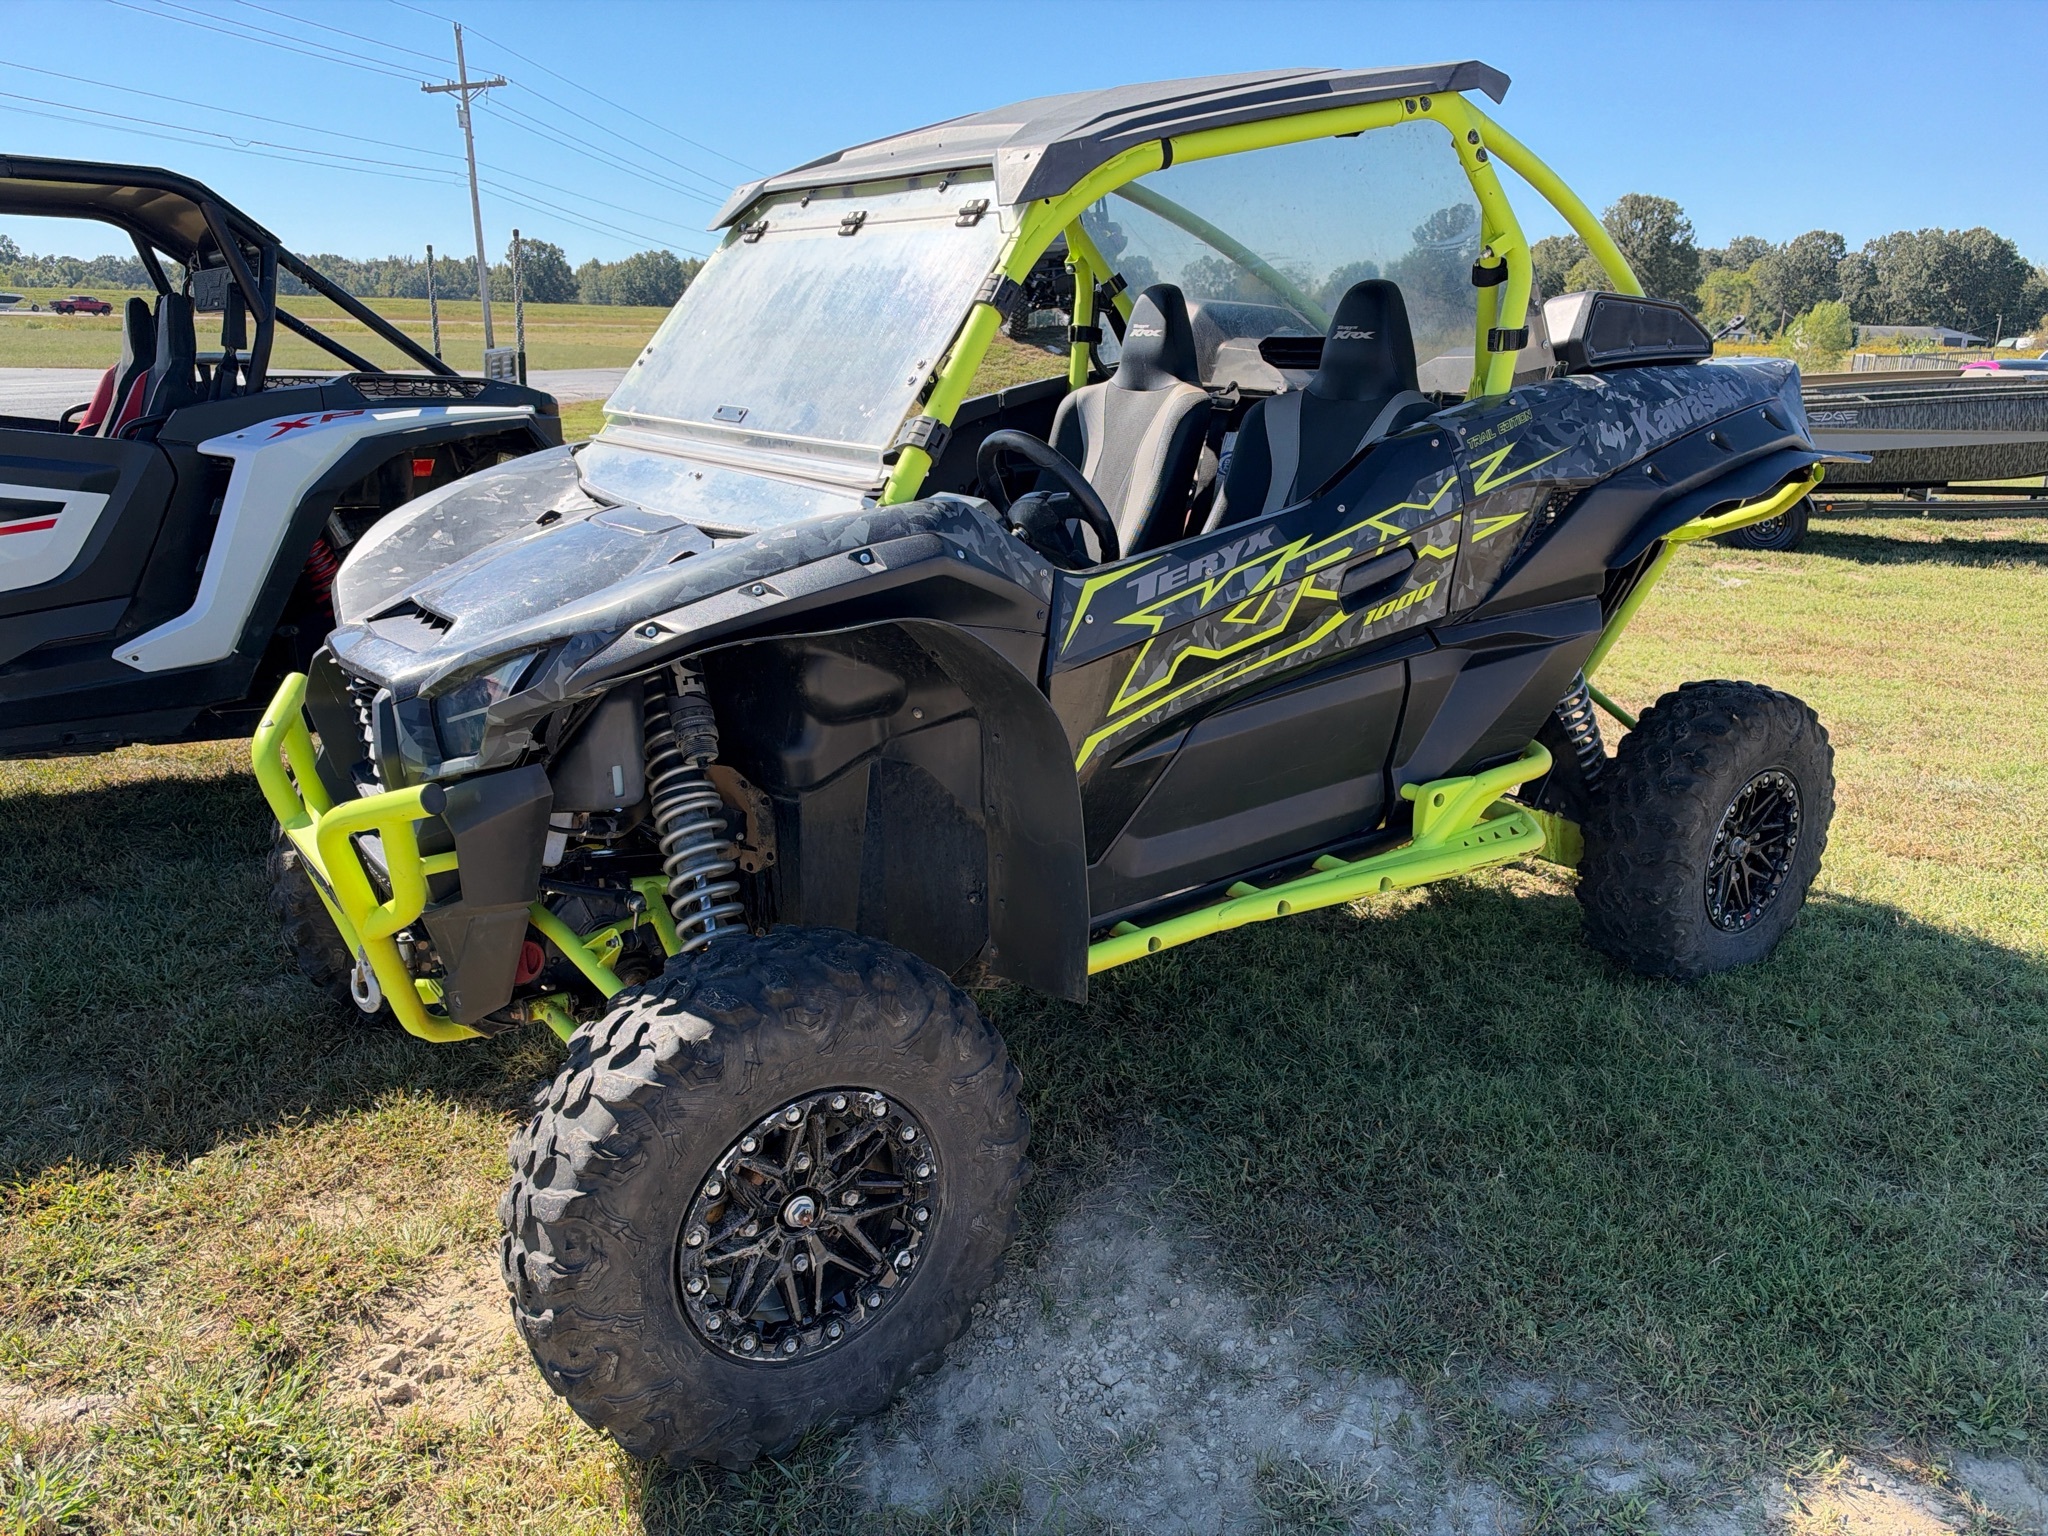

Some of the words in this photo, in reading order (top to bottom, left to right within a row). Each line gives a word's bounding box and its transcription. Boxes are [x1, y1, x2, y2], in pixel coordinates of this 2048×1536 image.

[1129, 329, 1162, 337] KRX
[1332, 330, 1376, 339] KRX
[263, 410, 366, 441] XP
[1467, 429, 1496, 449] TRAIL
[1498, 409, 1533, 434] EDITION
[1629, 379, 1747, 446] Kawasaki
[1363, 580, 1438, 626] 1000
